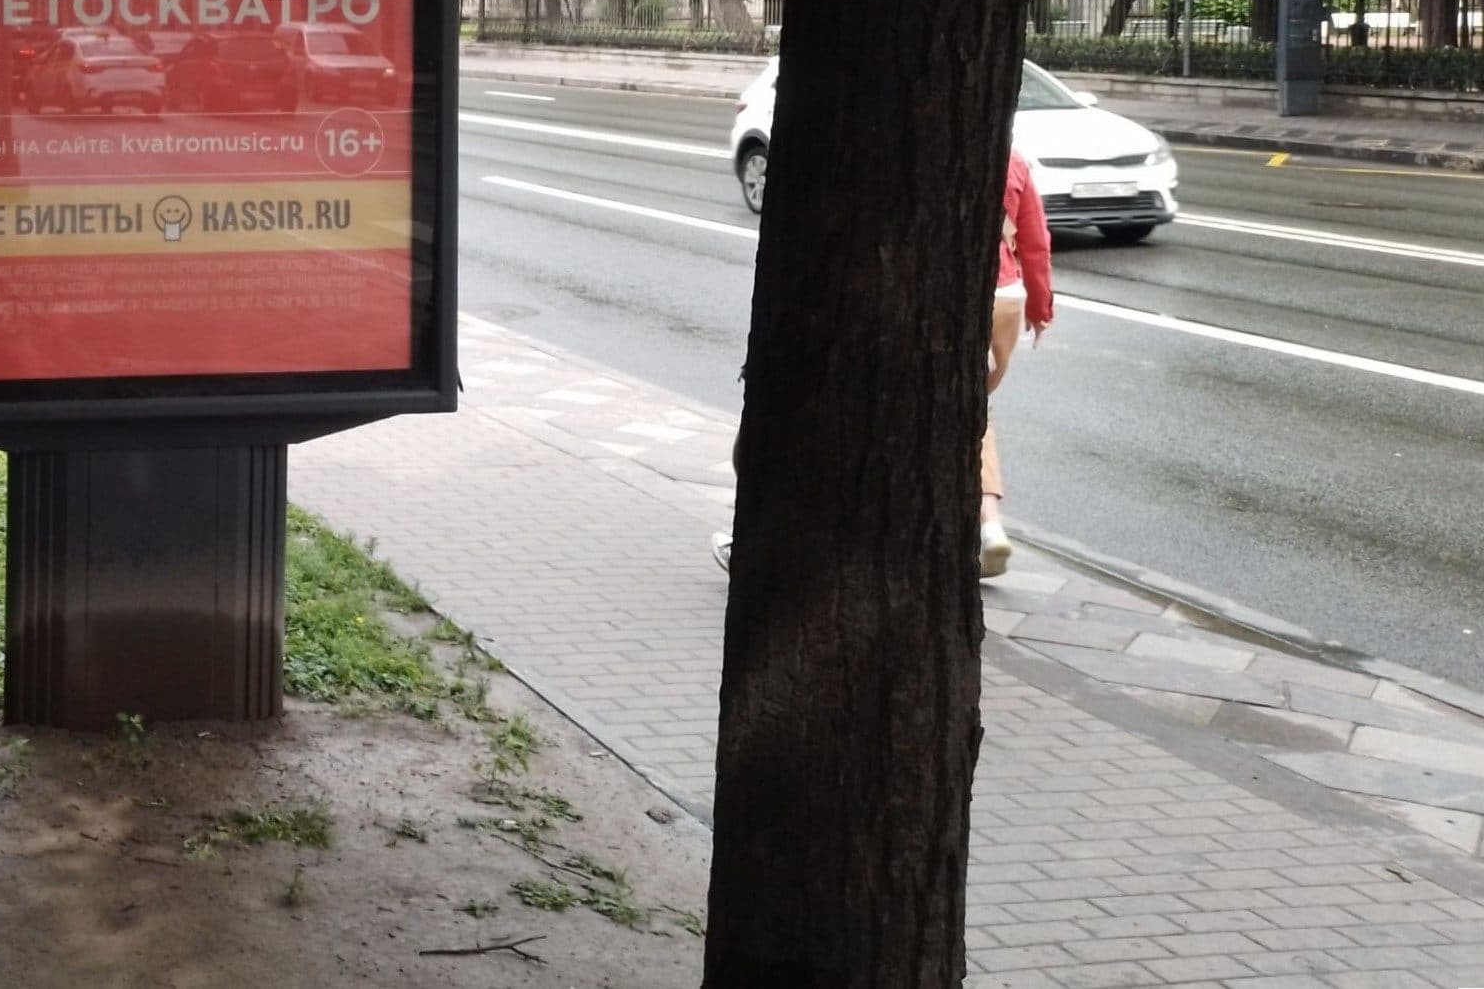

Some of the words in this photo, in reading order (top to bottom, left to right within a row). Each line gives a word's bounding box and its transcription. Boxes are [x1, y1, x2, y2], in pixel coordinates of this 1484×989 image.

[13, 139, 40, 155] НА
[121, 132, 305, 154] kvatromusic.ru
[324, 128, 383, 158] 16+
[15, 202, 144, 236] БИЛЕТЫ
[202, 198, 352, 232] KASSIR.RU
